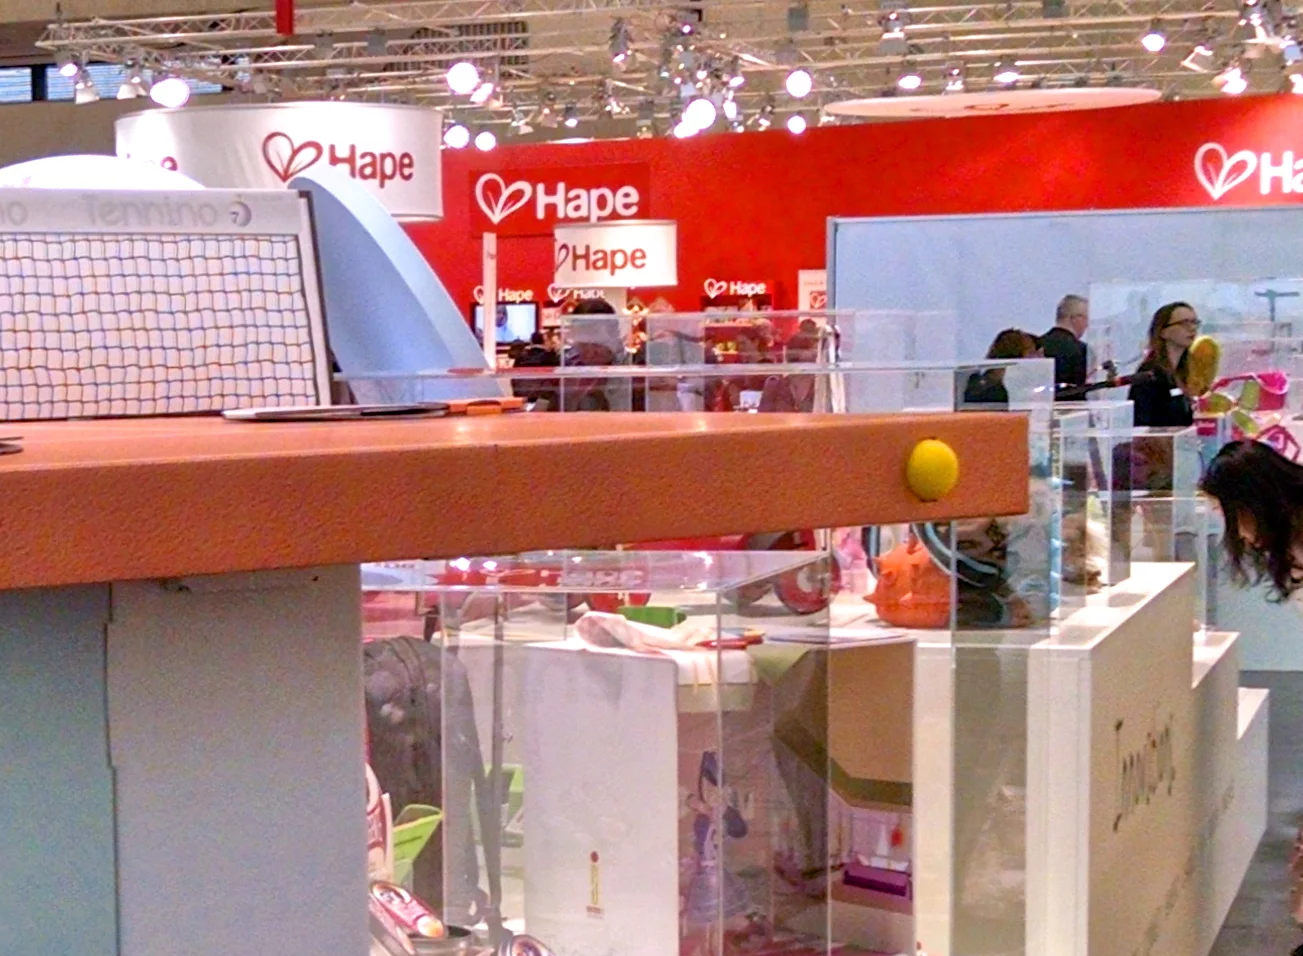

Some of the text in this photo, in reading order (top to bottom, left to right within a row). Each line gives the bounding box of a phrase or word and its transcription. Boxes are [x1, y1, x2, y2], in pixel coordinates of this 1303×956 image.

[328, 143, 415, 189] Hape
[80, 193, 218, 227] Tennino
[536, 181, 640, 223] Hape
[571, 243, 647, 276] Hape
[497, 286, 534, 304] Hape
[728, 280, 767, 298] Hape
